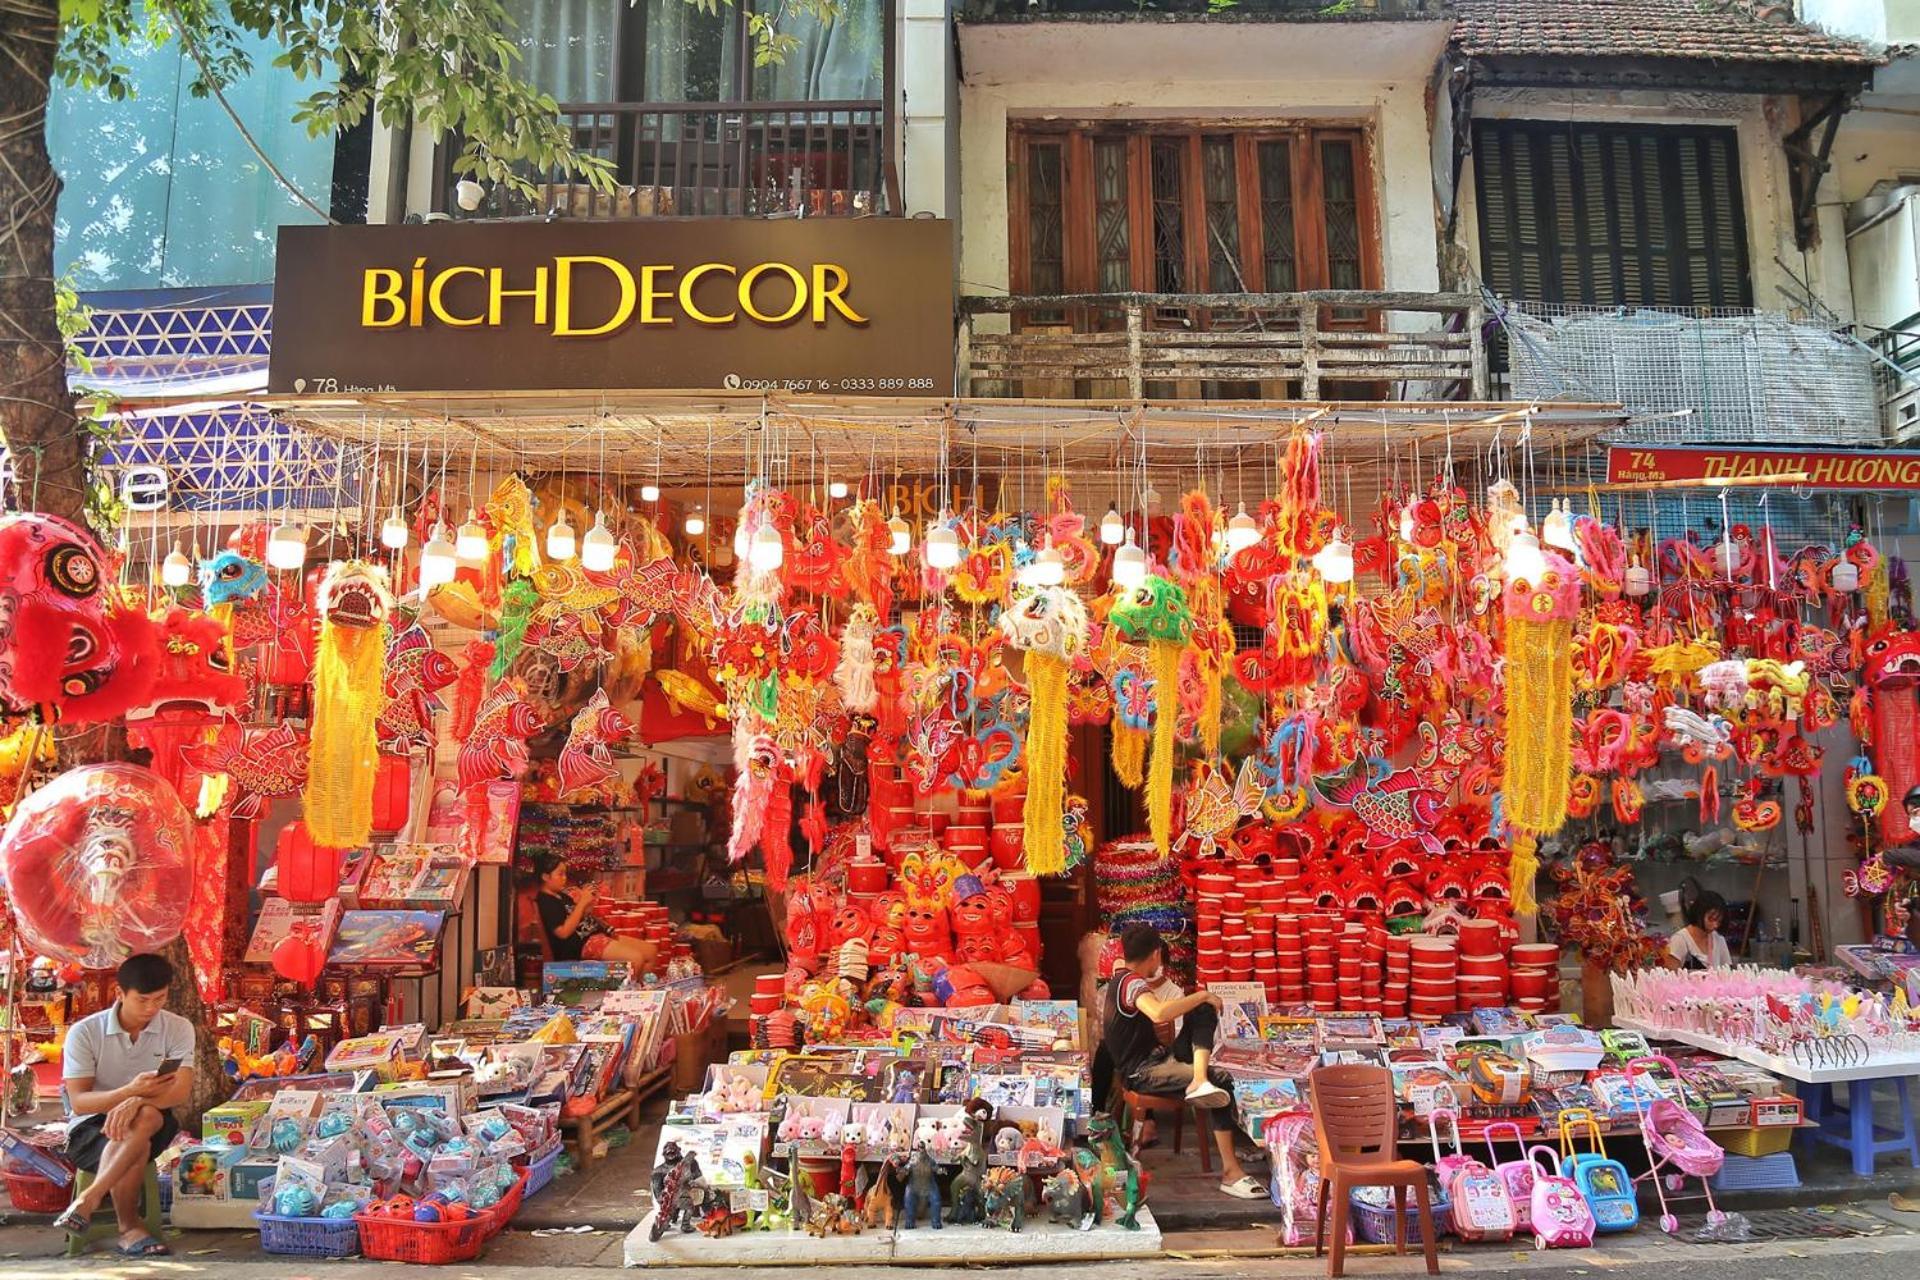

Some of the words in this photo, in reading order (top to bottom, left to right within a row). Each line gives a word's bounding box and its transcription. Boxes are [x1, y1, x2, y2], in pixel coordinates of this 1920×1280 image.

[312, 378, 339, 394] 78
[742, 379, 778, 390] 0904
[782, 379, 813, 390] 7667
[817, 379, 830, 390] 16
[840, 379, 875, 390] 0333
[878, 379, 905, 389] 889
[908, 379, 934, 389] 888
[1630, 452, 1656, 469] 74
[1704, 455, 1807, 479] THANH
[1811, 457, 1920, 483] HƯƠNG
